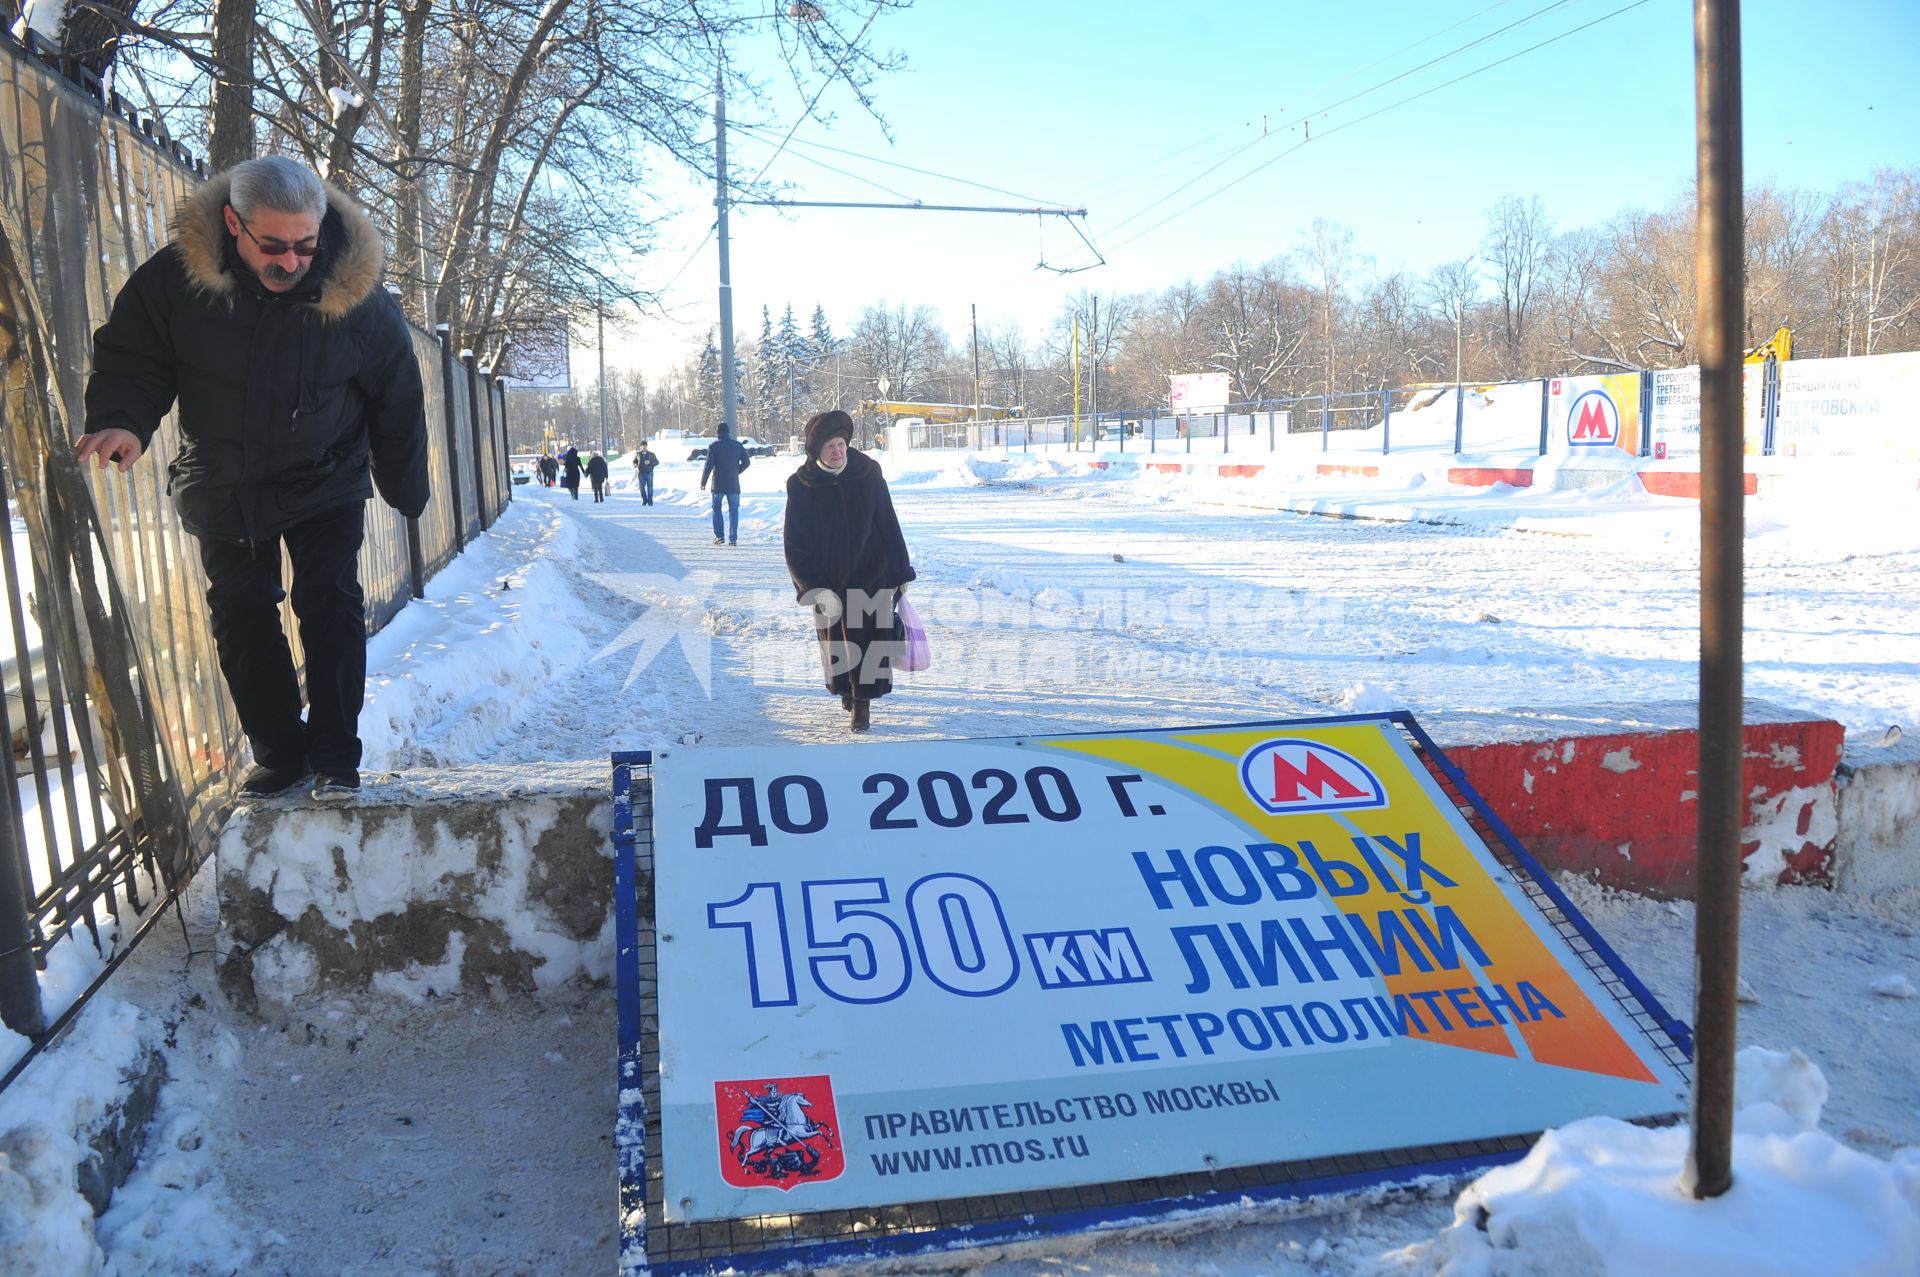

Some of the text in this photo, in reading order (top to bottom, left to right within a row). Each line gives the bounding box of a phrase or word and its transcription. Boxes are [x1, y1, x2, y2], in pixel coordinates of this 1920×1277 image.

[1656, 372, 1700, 384] СТРОИТЕЛЬС
[1656, 383, 1690, 395] ТРЕТЬЕГО
[1785, 380, 1826, 393] СТАНЦИЯ
[1656, 394, 1700, 406] ПЕРЕСАДОЧН
[1682, 409, 1700, 420] ДЕЛ
[1681, 423, 1700, 435] НИЖ
[1783, 419, 1821, 437] ПАРК
[694, 774, 829, 849] ДО
[861, 765, 1082, 830] 2020
[1131, 831, 1459, 910] НОВЫХ
[706, 872, 1021, 1009] 150
[1169, 889, 1494, 995] ЛИНИЙ
[1060, 980, 1567, 1067] МЕТРОПОЛИТЕНА
[864, 1078, 1281, 1141] ПРАВИТЕЛЬСТВО МОСКВЫ
[870, 1132, 1091, 1178] www.mos.ru
